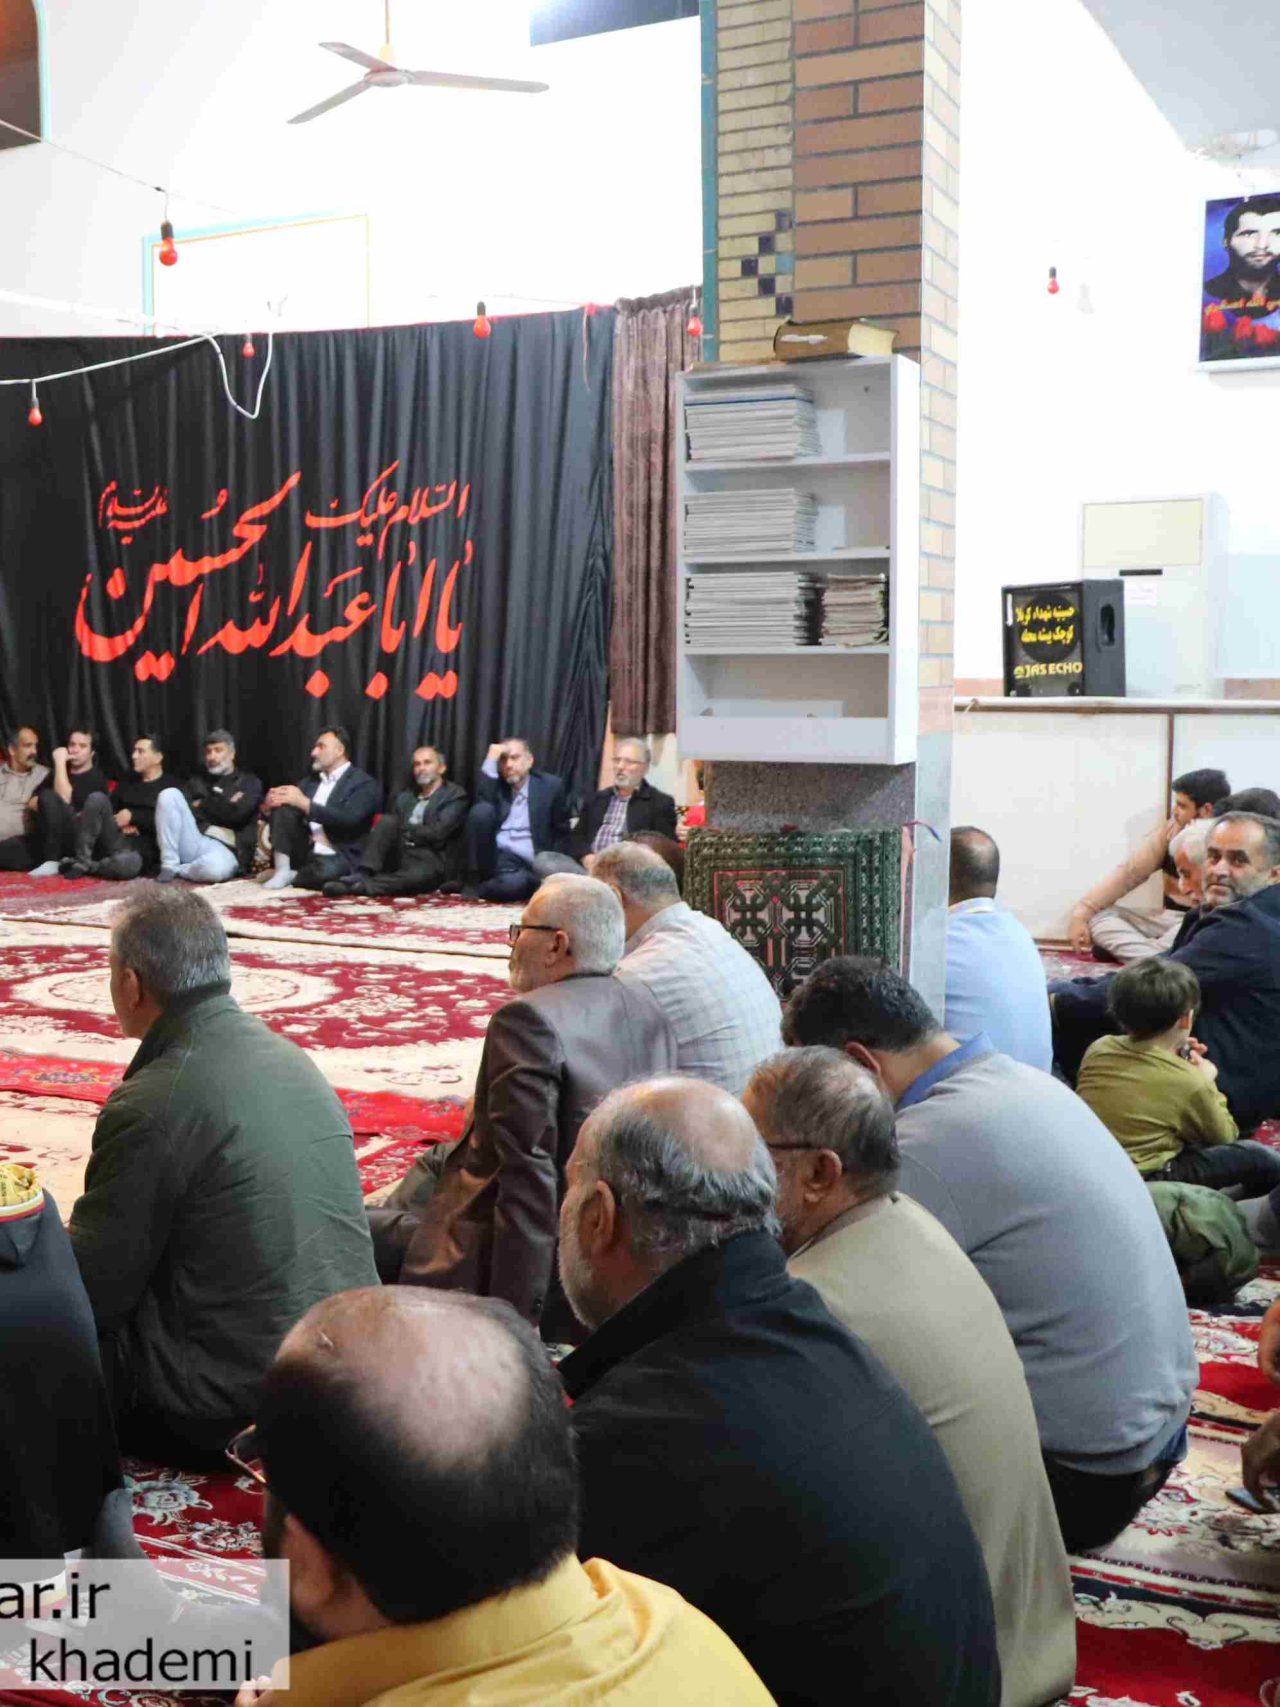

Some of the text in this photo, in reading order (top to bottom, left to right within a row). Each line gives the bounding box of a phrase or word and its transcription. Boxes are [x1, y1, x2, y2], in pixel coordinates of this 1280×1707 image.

[305, 458, 471, 561] السلام علیک
[76, 470, 302, 683] الحسین
[1048, 661, 1083, 675] ECHO
